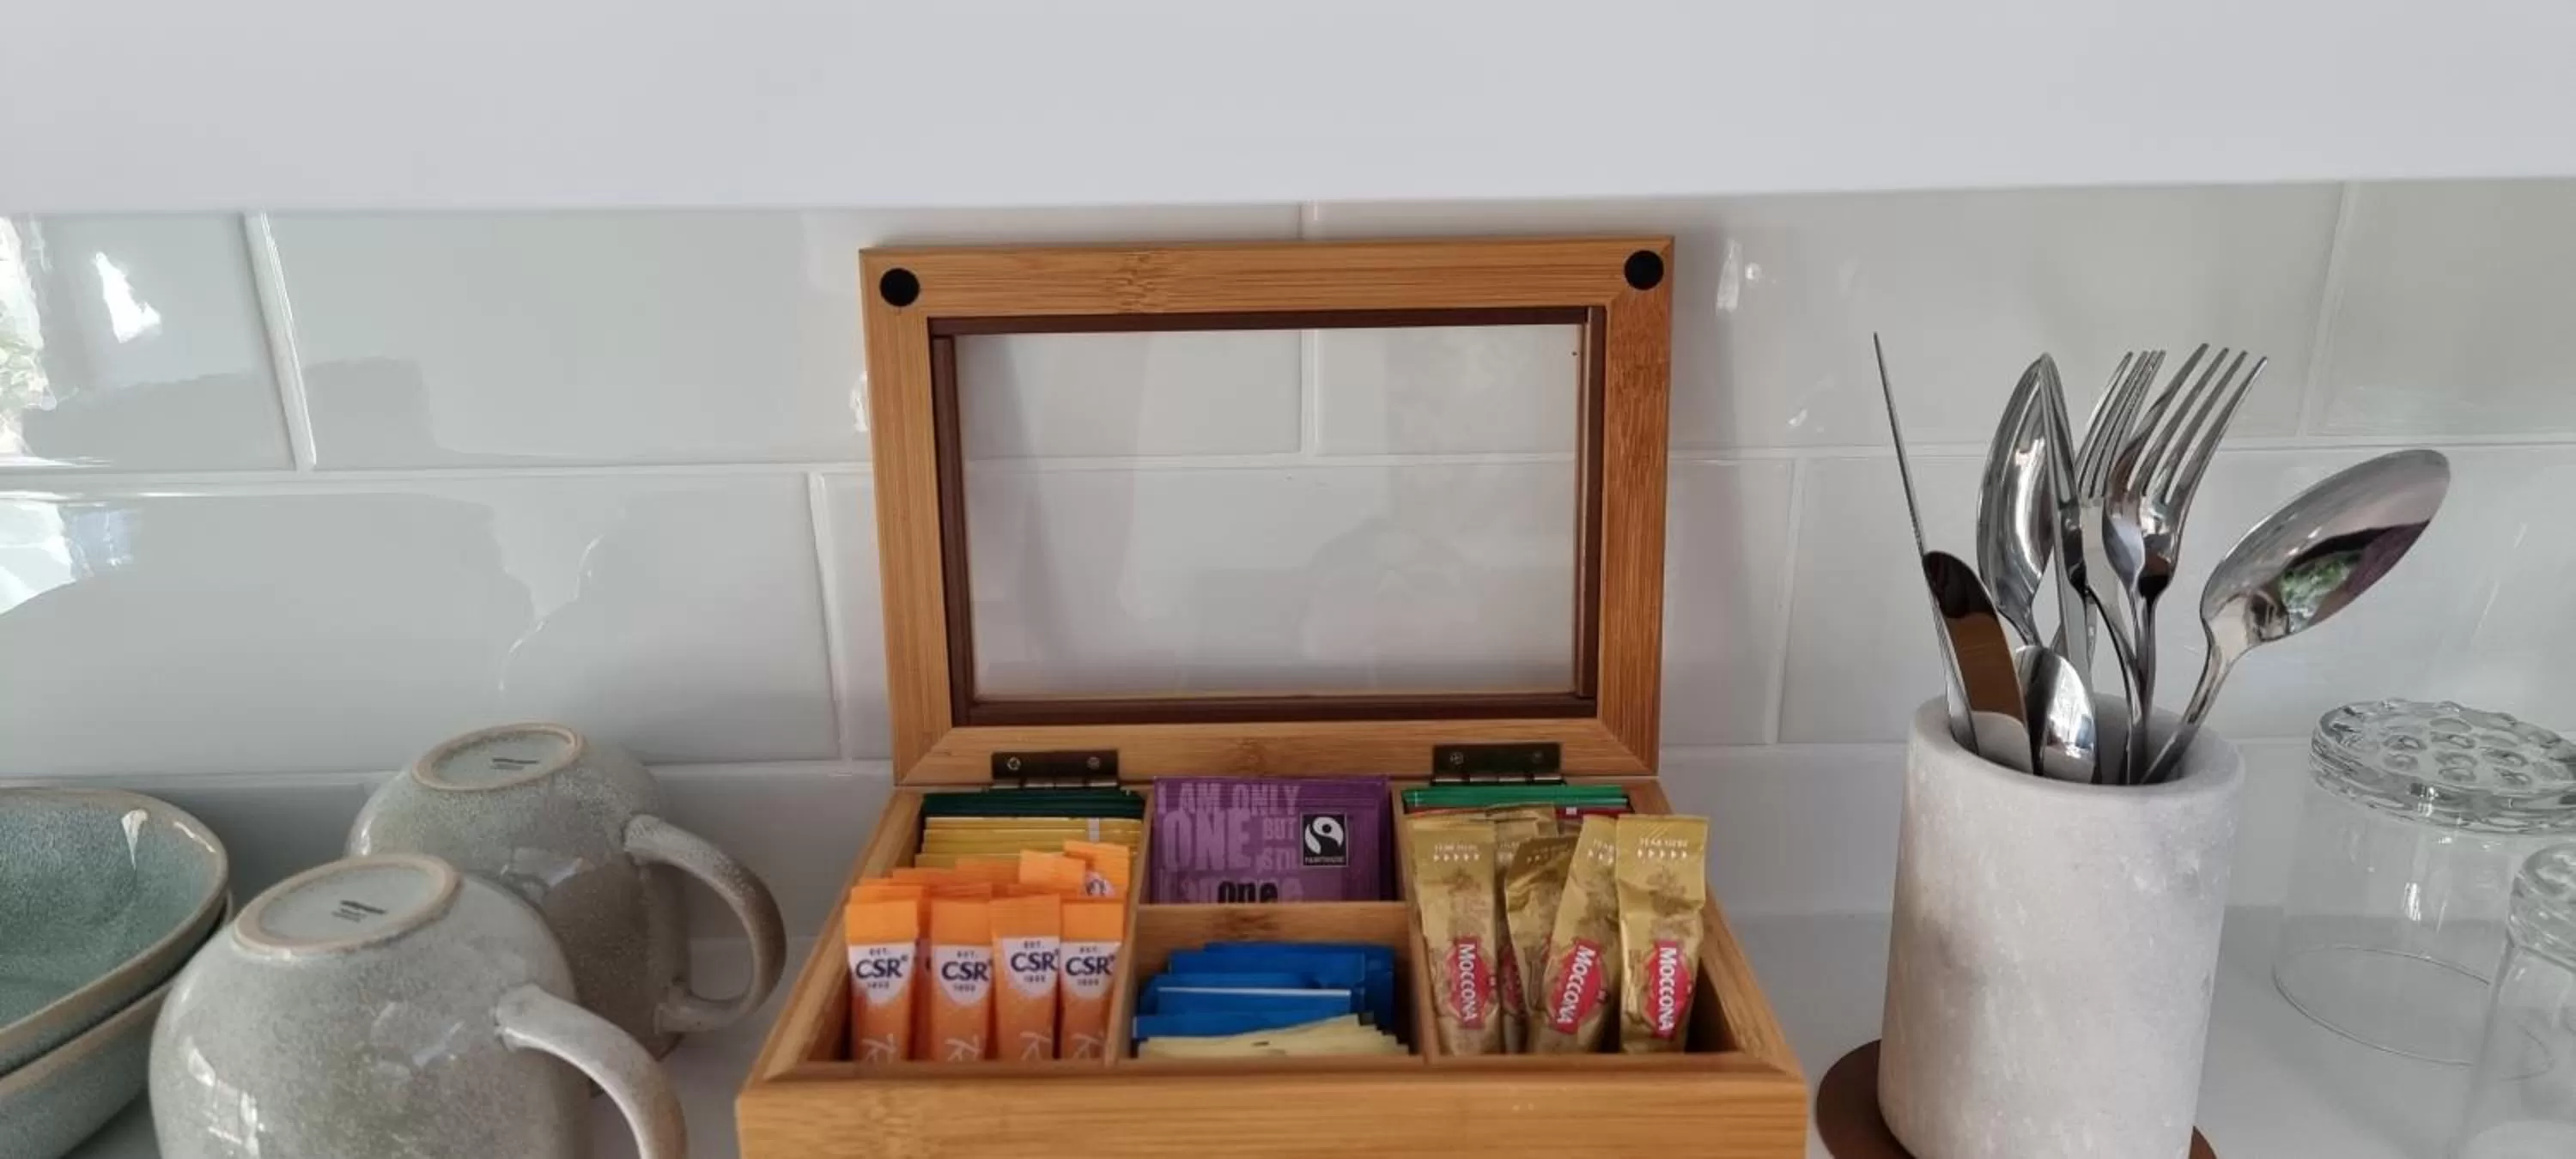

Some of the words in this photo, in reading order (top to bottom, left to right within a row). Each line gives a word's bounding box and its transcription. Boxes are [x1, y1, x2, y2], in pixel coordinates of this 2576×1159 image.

[1157, 782, 1166, 815] I
[1178, 782, 1221, 814] AM
[1231, 784, 1300, 816] ONLY
[1163, 808, 1250, 870] ONE
[1262, 817, 1297, 840] BUT
[1218, 880, 1279, 903] one
[856, 957, 903, 979] CSR
[941, 960, 989, 981] CSR
[1011, 950, 1060, 973] CSR
[1065, 956, 1112, 977] CSR
[1458, 944, 1478, 1022] MOCCONA
[1557, 945, 1597, 1026] MOCCONA
[1658, 947, 1678, 1031] MOCCONA
